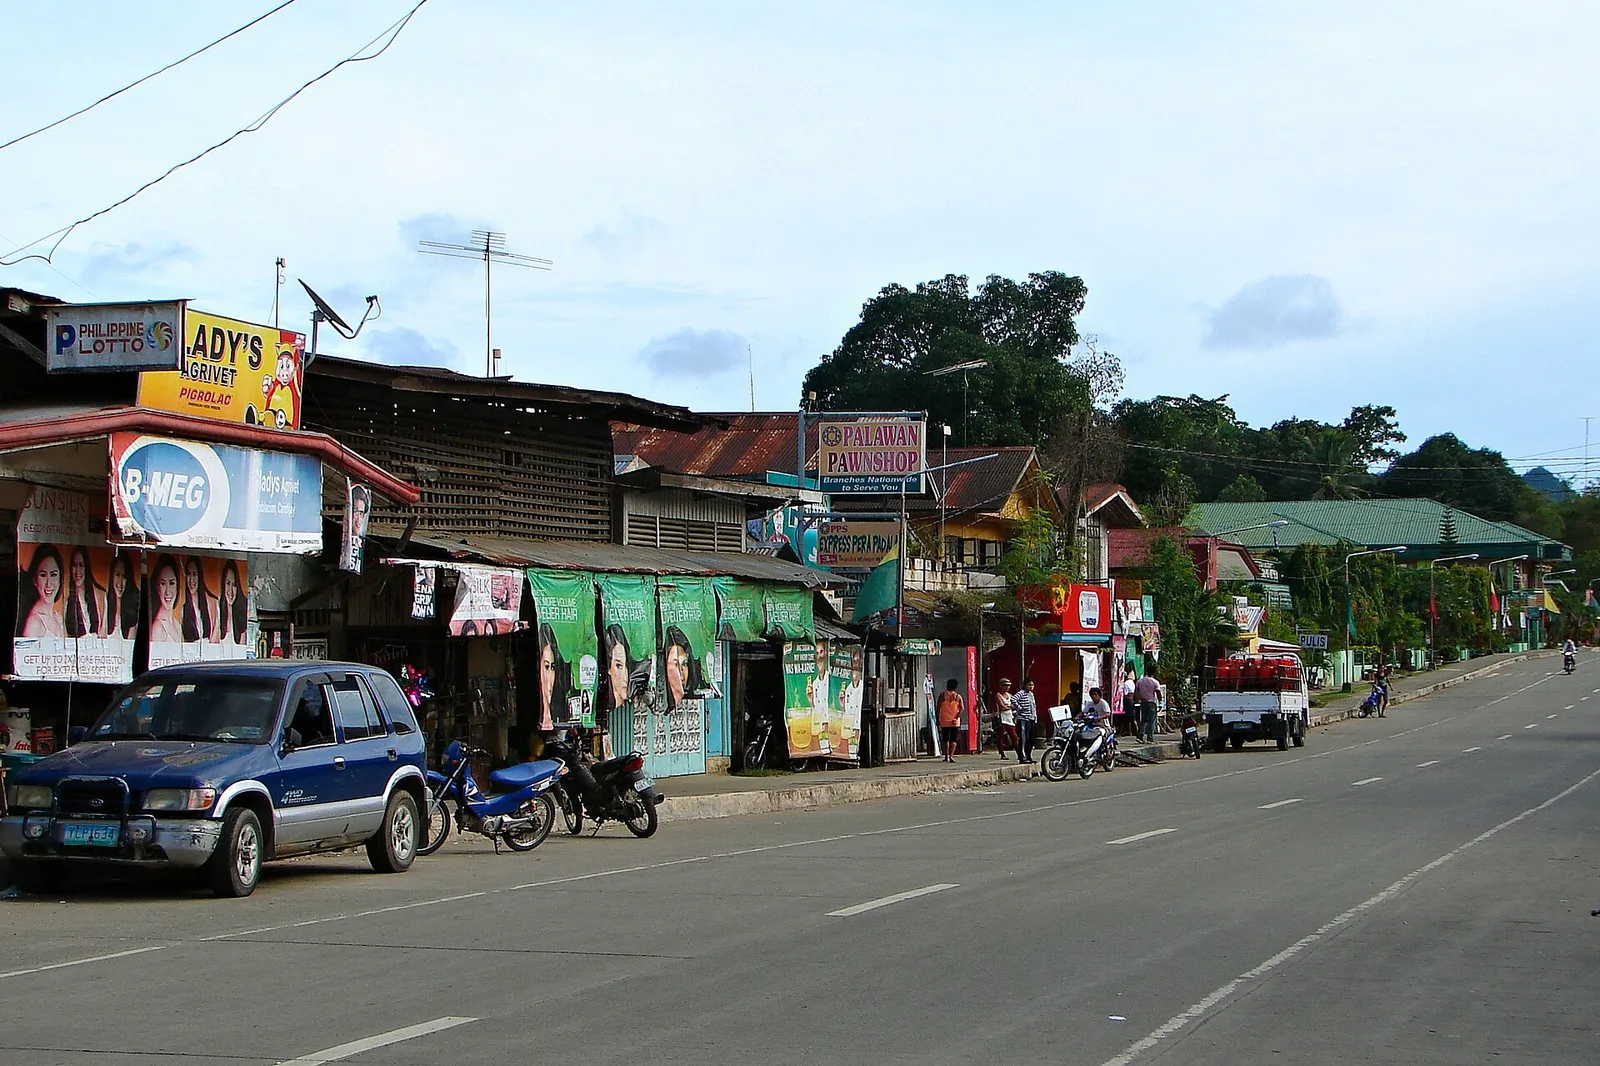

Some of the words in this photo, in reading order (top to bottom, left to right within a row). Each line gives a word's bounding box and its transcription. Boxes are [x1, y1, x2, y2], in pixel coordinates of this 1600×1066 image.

[79, 322, 144, 338] PHILIPPINE
[79, 338, 144, 354] LOTTO
[186, 324, 264, 371] ADY'S
[180, 361, 238, 388] AGRIVET
[180, 386, 232, 406] PIGROLAC
[843, 425, 919, 447] PALAWAN
[827, 451, 918, 473] PAWNSHOP
[823, 476, 865, 484] Branches
[867, 476, 918, 484] Nationwde
[125, 468, 206, 510] B-MEG
[830, 525, 848, 533] PPS
[819, 534, 852, 553] EXPRESS
[852, 534, 872, 554] PERA
[561, 607, 578, 621] HAIR
[1300, 635, 1325, 647] PULIS
[24, 655, 39, 664] GET
[52, 654, 63, 664] TO
[36, 666, 54, 675] FOR
[90, 666, 106, 675] SOFT
